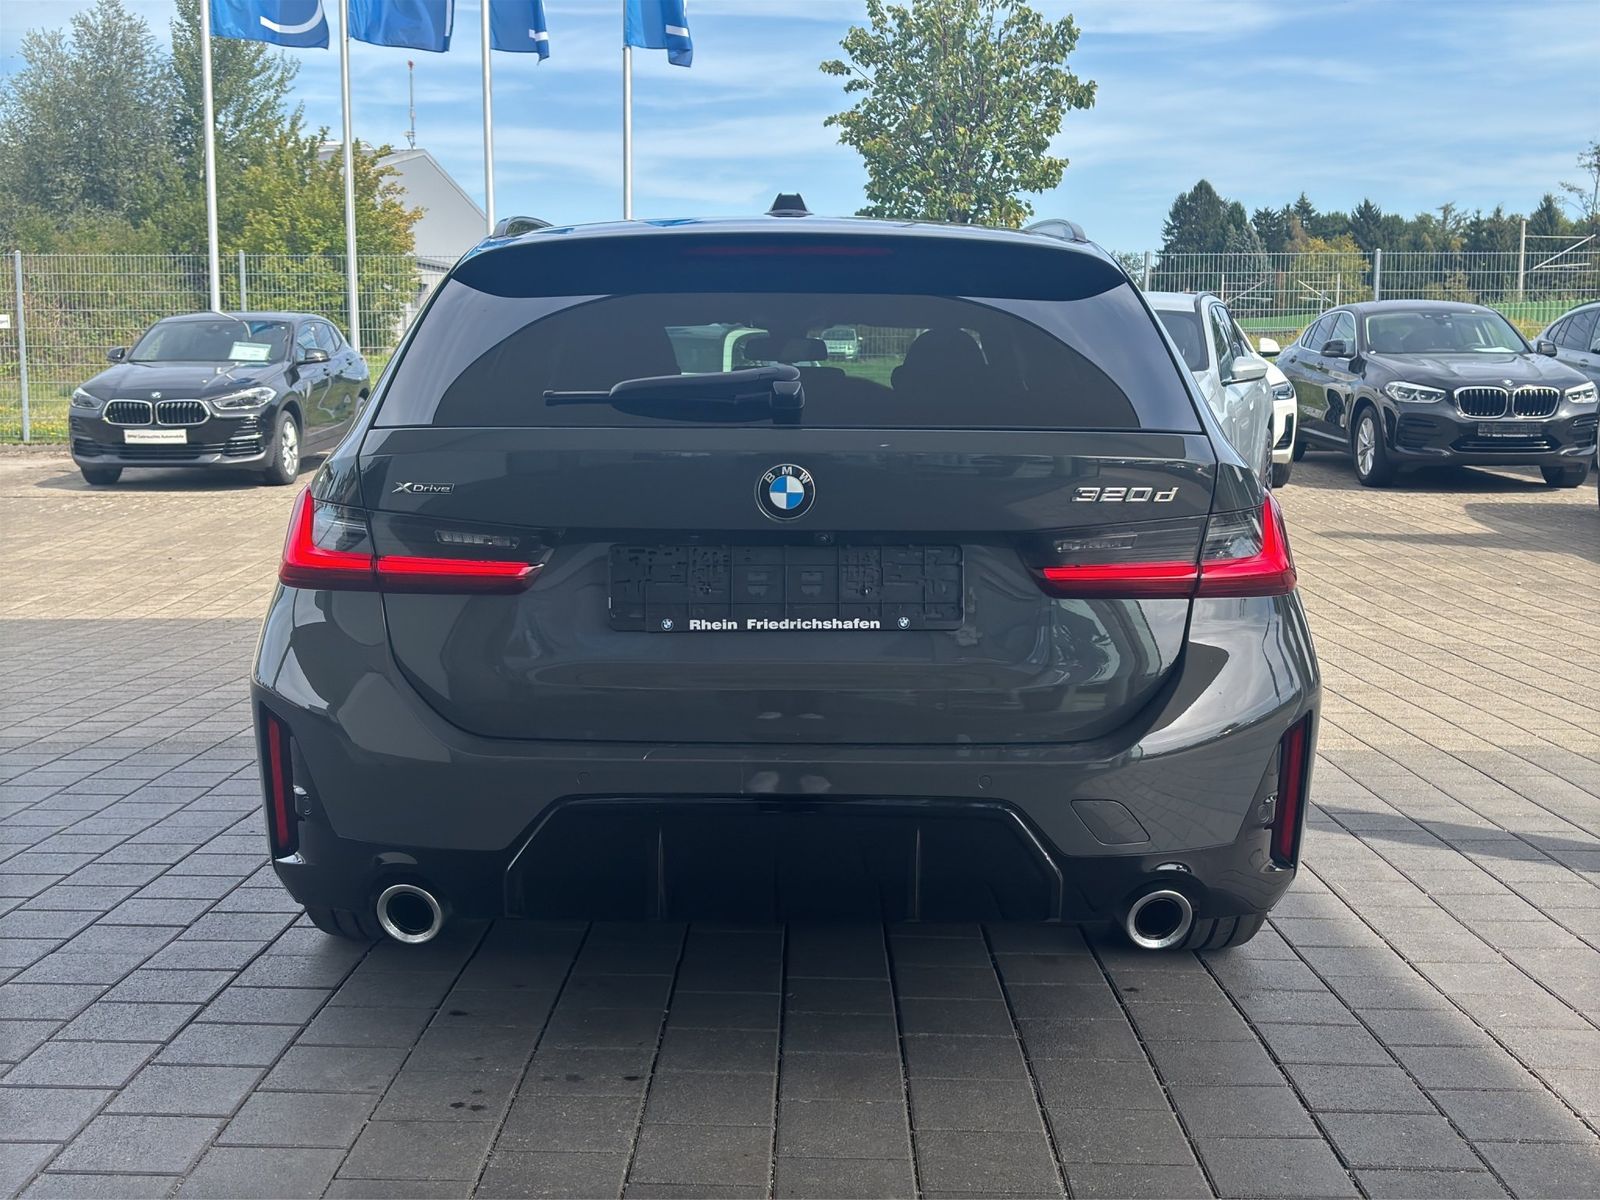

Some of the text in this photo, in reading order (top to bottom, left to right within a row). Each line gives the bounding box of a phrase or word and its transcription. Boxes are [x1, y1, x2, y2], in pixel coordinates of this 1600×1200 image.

[764, 466, 811, 484] BMW
[1072, 487, 1179, 502] 320d
[689, 618, 881, 630] Rhein Friedrichshafen
